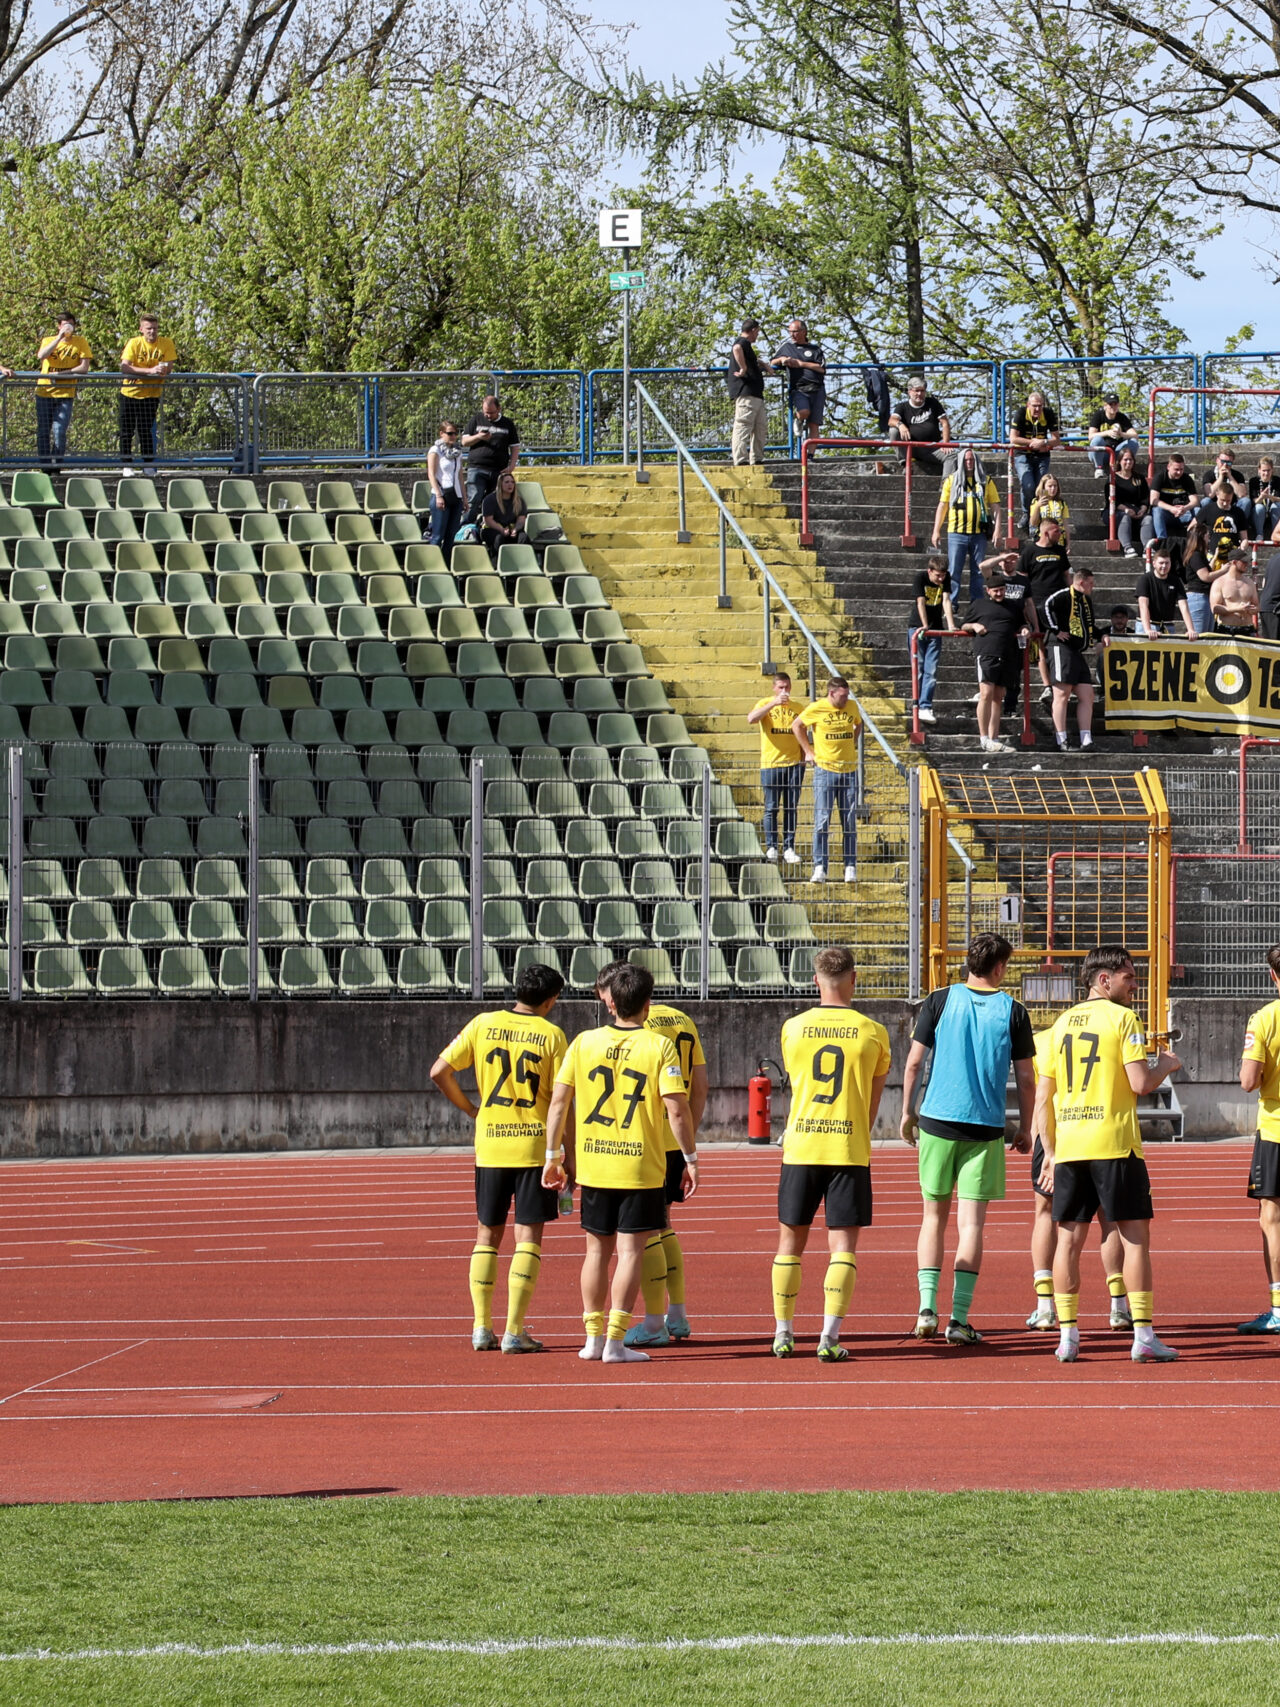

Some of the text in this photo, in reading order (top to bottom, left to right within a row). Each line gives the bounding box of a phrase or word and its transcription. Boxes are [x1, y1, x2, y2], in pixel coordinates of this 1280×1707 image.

[612, 214, 629, 241] E
[1108, 650, 1200, 703] SZENE
[1002, 898, 1012, 921] 1
[1068, 1014, 1091, 1027] FREY
[486, 1027, 547, 1047] ZEJNULLAHU
[802, 1026, 859, 1039] FENNINGER
[605, 1045, 632, 1061] GÖTZ
[1059, 1031, 1101, 1093] 17
[485, 1046, 543, 1109] 25
[812, 1044, 845, 1105] 9
[583, 1064, 647, 1129] 27
[495, 1122, 543, 1131] BAYREUTHER
[805, 1118, 853, 1127] BAYREUTHER
[805, 1125, 853, 1135] BRAUHAUS
[495, 1129, 543, 1138] BRAUHAUS
[594, 1146, 642, 1157] BRAUHAUS
[595, 1138, 642, 1149] BAYREUTHER
